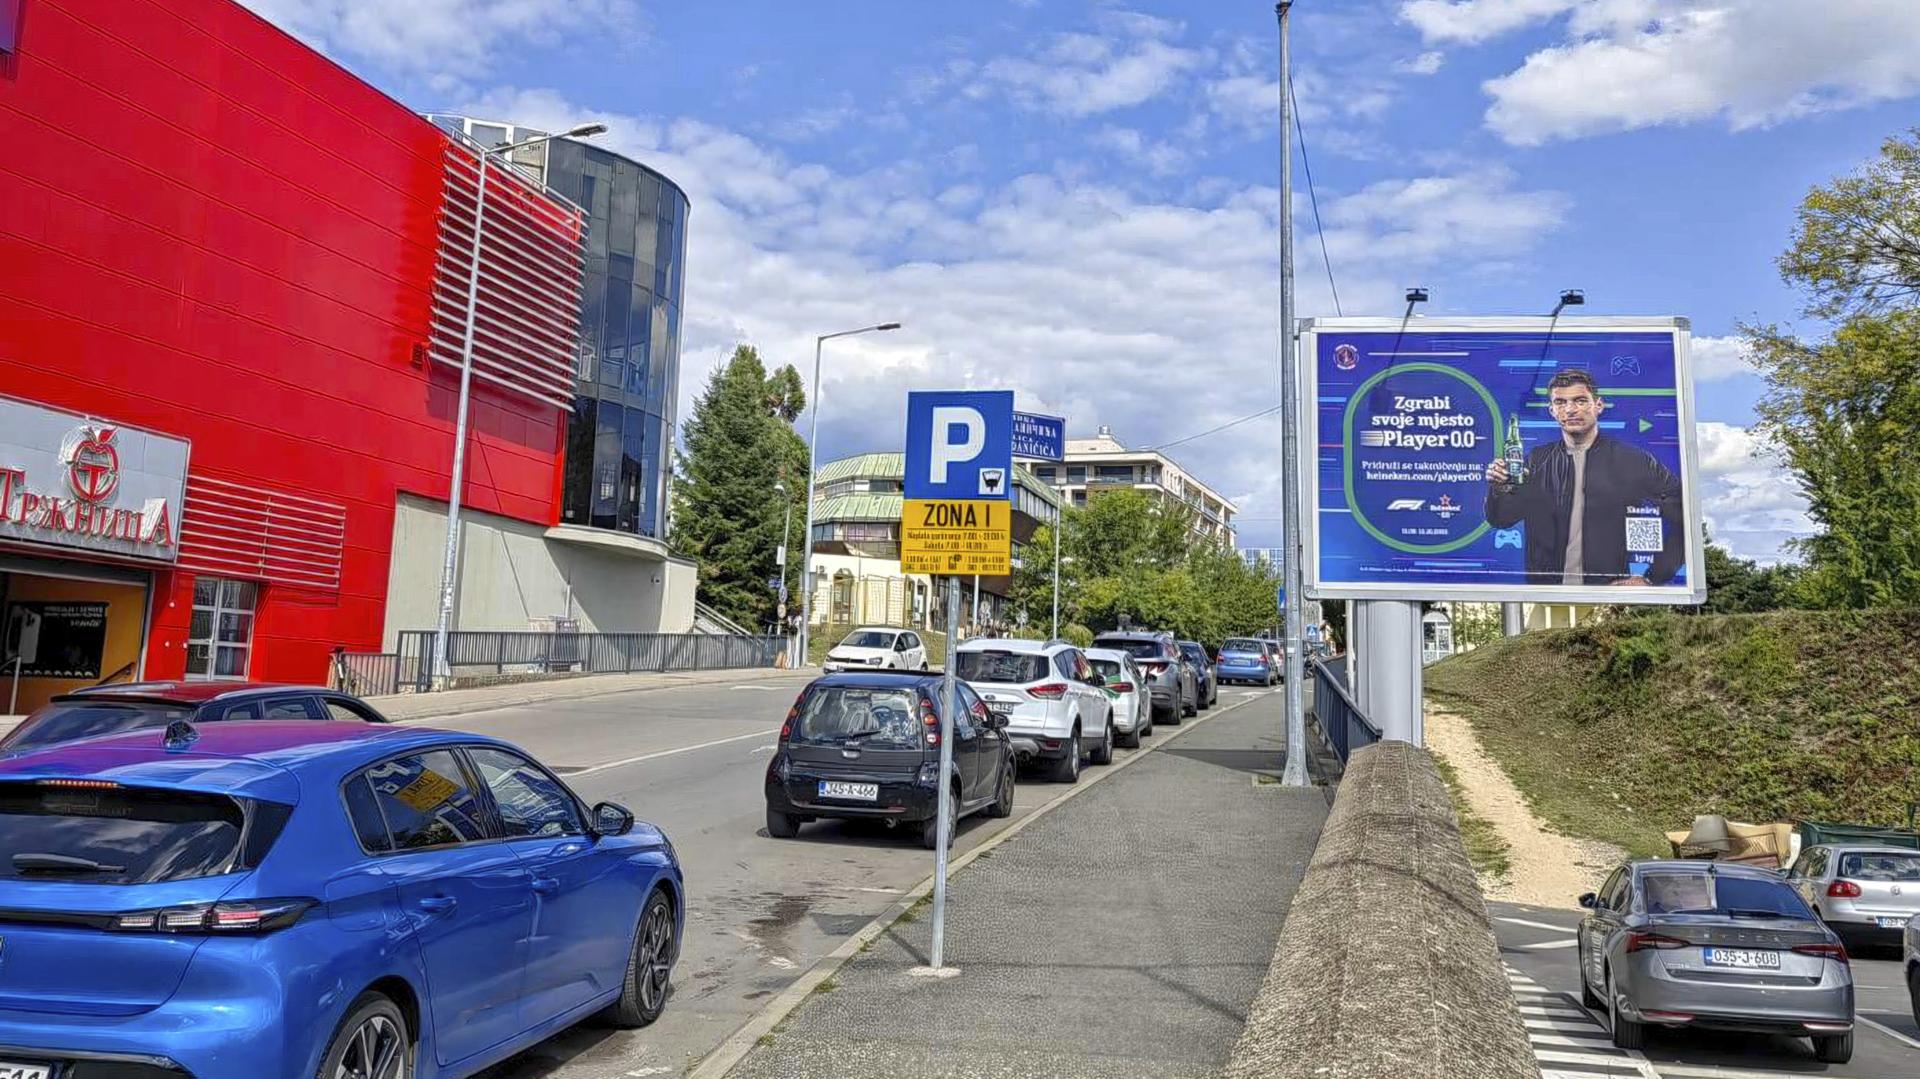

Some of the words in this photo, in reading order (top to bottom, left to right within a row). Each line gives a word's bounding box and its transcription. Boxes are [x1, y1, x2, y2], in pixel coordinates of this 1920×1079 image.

[1394, 396, 1450, 412] Zgrabi
[1371, 414, 1415, 429] svoje
[1418, 413, 1475, 430] mjesto
[929, 406, 986, 484] P
[1384, 430, 1450, 451] Player
[1402, 463, 1413, 471] se
[923, 503, 977, 527] ZONA
